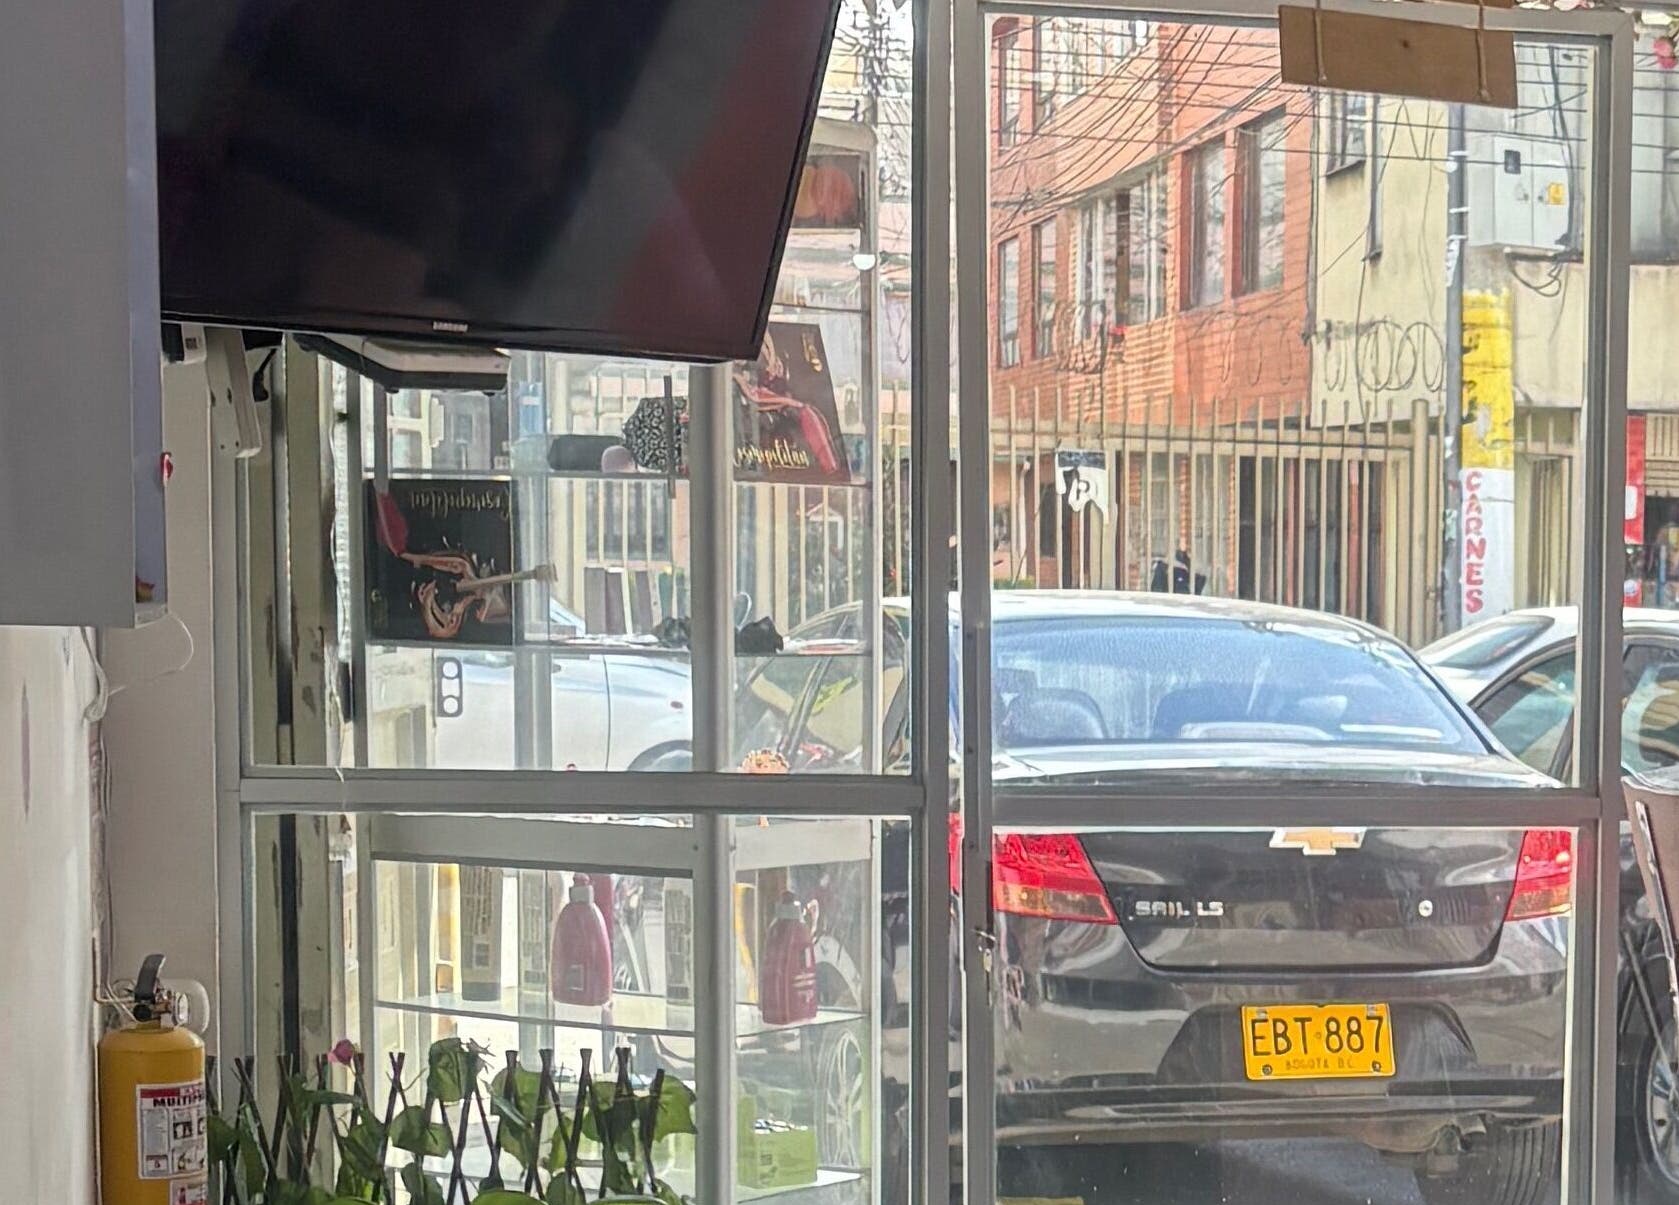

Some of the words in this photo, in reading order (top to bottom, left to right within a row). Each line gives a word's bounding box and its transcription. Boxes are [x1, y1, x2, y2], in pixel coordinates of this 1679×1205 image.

[1465, 470, 1486, 614] CARNES
[1135, 900, 1190, 918] SAIL
[1197, 901, 1224, 917] LS
[1250, 1017, 1313, 1057] EBT
[1325, 1015, 1384, 1054] 887
